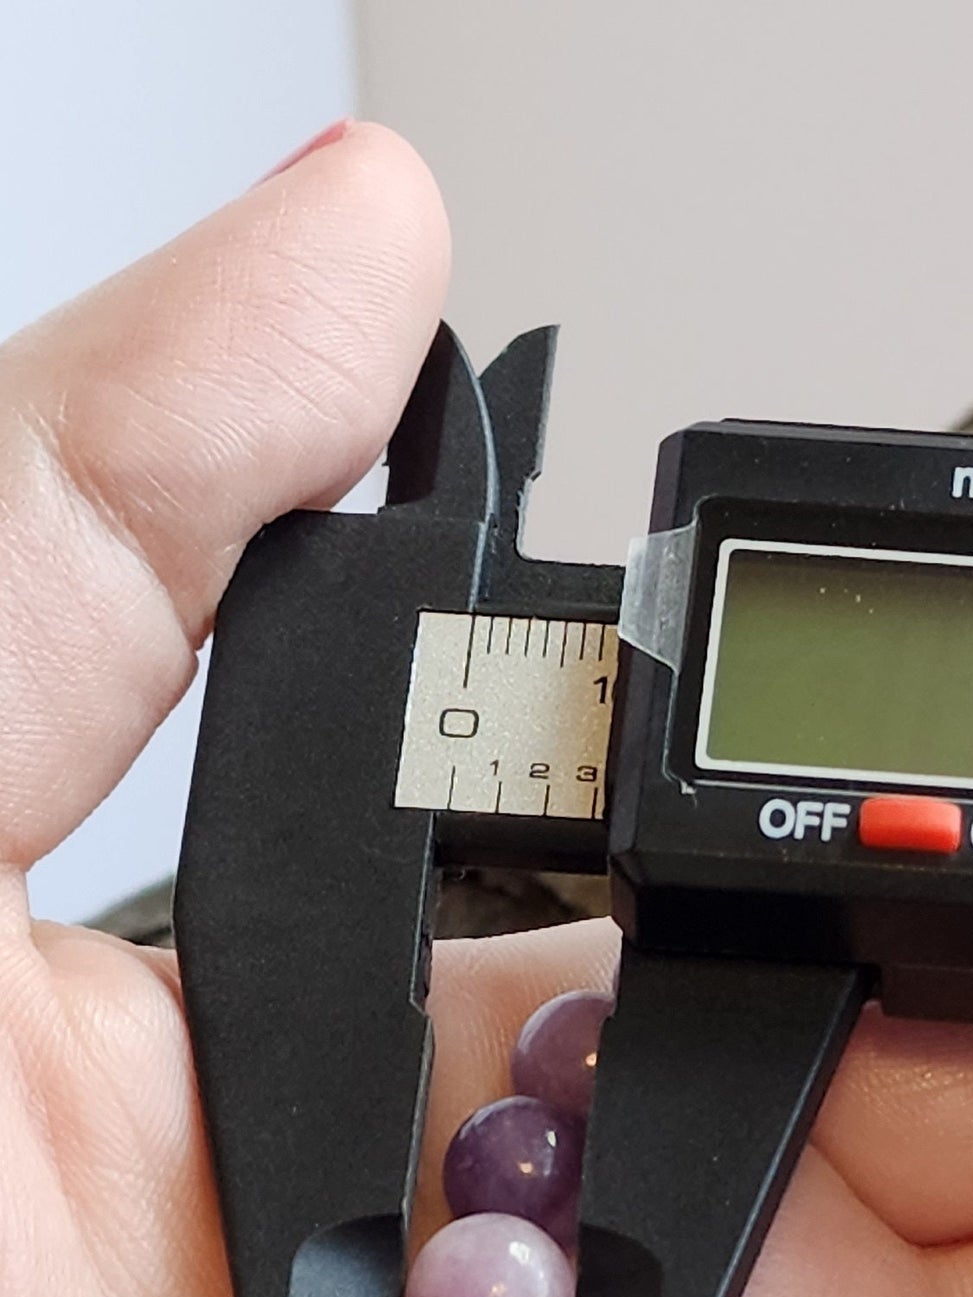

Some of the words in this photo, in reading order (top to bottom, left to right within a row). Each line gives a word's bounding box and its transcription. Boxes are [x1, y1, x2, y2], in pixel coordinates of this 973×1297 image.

[593, 676, 613, 704] 1
[528, 762, 550, 780] 2
[575, 765, 598, 783] 3
[758, 798, 851, 842] OFF
